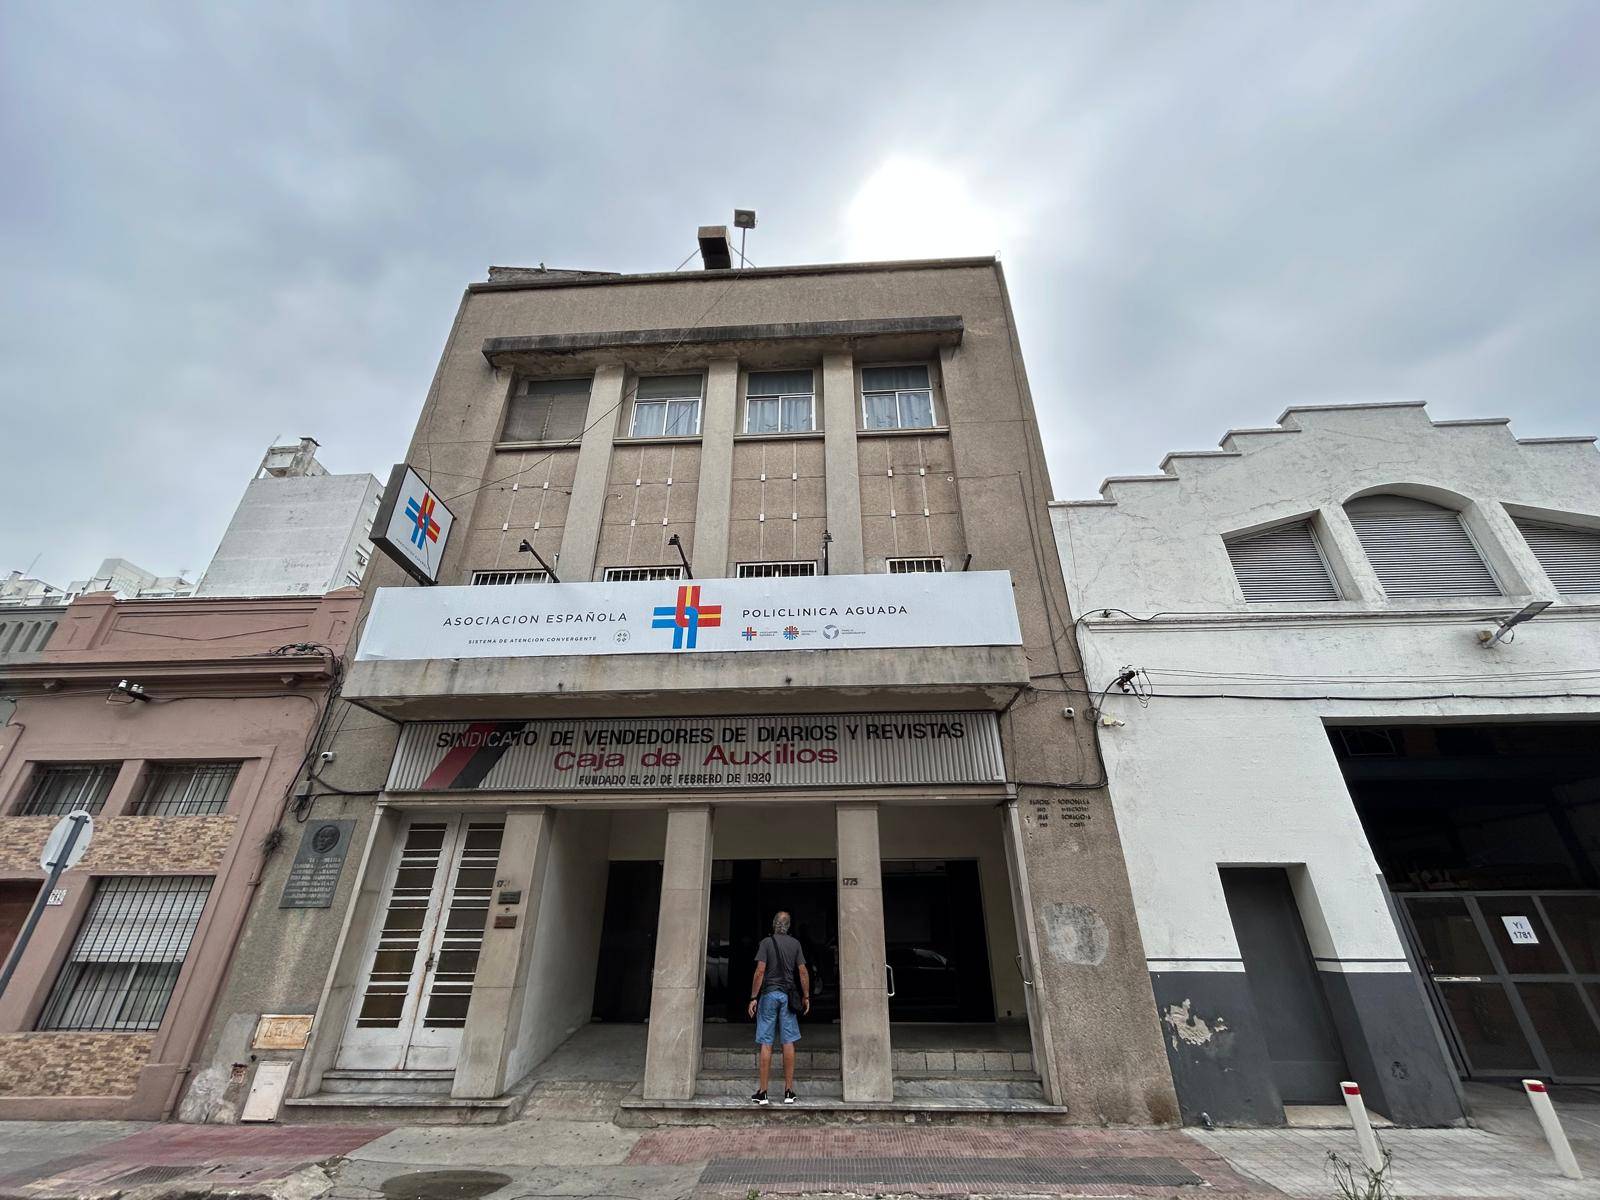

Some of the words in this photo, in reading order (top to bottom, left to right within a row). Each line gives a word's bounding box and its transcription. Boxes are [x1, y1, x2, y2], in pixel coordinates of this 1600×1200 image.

[442, 614, 540, 627] ASOCIACION
[546, 611, 628, 624] ESPAÑOLA
[742, 606, 838, 618] POLICLINICA
[845, 605, 908, 616] AGUADA
[436, 730, 538, 748] SINDICATO
[550, 730, 574, 746] DE
[584, 728, 713, 746] VENDEDORES
[722, 727, 746, 743] DE
[757, 725, 838, 742] DIARIOS
[846, 724, 859, 740] Y
[866, 722, 965, 740] REVISTAS
[554, 747, 625, 772] Caja
[640, 747, 681, 768] de
[702, 743, 839, 766] Auxilios
[578, 774, 626, 786] FUNDADO
[629, 774, 641, 785] EL
[642, 774, 656, 785] 20
[659, 774, 673, 784] DE
[678, 773, 722, 784] FEBRERO
[726, 773, 741, 783] DE
[747, 772, 772, 783] 1920
[1513, 931, 1532, 939] 1781
